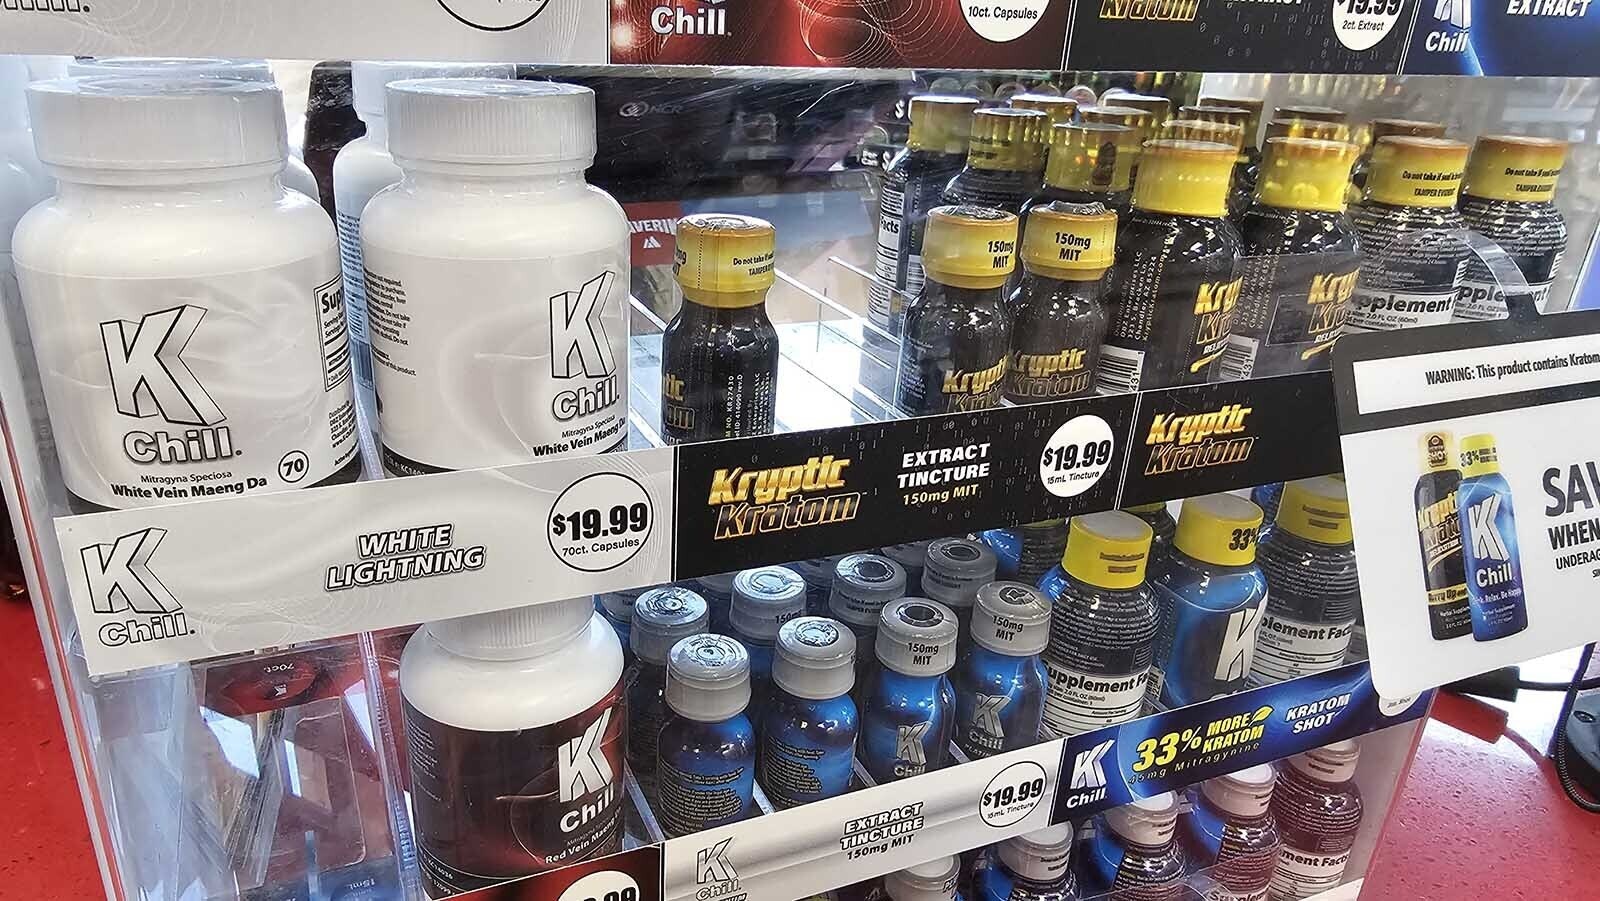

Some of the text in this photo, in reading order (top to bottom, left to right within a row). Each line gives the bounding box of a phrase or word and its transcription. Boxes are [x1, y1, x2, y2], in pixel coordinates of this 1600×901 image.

[968, 5, 1038, 20] 10ct. Capsules
[1506, 0, 1592, 17] EXTRACT
[1342, 20, 1384, 31] 2ct. Extract
[988, 240, 1014, 254] 150mg
[1054, 232, 1091, 249] 150mg
[992, 255, 1009, 269] MIT
[1059, 248, 1082, 262] MIT
[550, 270, 616, 379] K
[100, 304, 227, 427] K
[1425, 366, 1476, 385] WARNING:
[1476, 364, 1496, 379] This
[1497, 360, 1531, 380] product
[1532, 355, 1569, 373] contains
[1146, 404, 1252, 445] Kryptic
[533, 443, 569, 456] White
[570, 436, 593, 449] Vein
[594, 424, 619, 442] Maeng
[283, 459, 304, 476] 70
[902, 443, 991, 469] EXTRACT
[1043, 439, 1111, 471] $19.99
[1144, 436, 1255, 476] Kratom
[111, 477, 268, 498] White Vein Maeng Da
[140, 470, 232, 485] Mitragyna Speciosa
[708, 455, 850, 505] Kryptic
[897, 462, 990, 489] TINCTURE
[1047, 471, 1099, 485] 15mL Tincture
[903, 483, 979, 506] 150mg MIT
[552, 502, 648, 541] $19.99
[713, 491, 860, 541] Kratom
[356, 522, 454, 559] WHITE
[562, 537, 640, 557] 70ct. Capsules
[1548, 518, 1600, 550] WHEN
[80, 527, 183, 614] K
[325, 545, 487, 592] LIGHTNING
[1476, 562, 1512, 588] Chill
[992, 615, 1024, 632] 150mg
[995, 629, 1015, 641] MIT
[908, 642, 939, 655] 150mg
[913, 655, 932, 666] MIT
[1285, 692, 1350, 721] KRATOM
[1206, 712, 1251, 737] MORE
[1292, 712, 1336, 734] SHOT
[1132, 726, 1201, 772] 33%
[1202, 725, 1264, 754] KRATOM
[558, 707, 614, 803] K
[1069, 739, 1114, 790] K
[1175, 742, 1260, 772] Mitragynine
[983, 778, 1043, 808] $19.99
[560, 782, 614, 833] Chill
[844, 802, 924, 833] EXTRACT
[1007, 802, 1034, 813] Tincture
[840, 816, 924, 850] TINCTURE
[847, 833, 914, 859] 150mg MIT
[545, 850, 566, 863] Red
[568, 840, 590, 855] Vein
[696, 836, 741, 885] K
